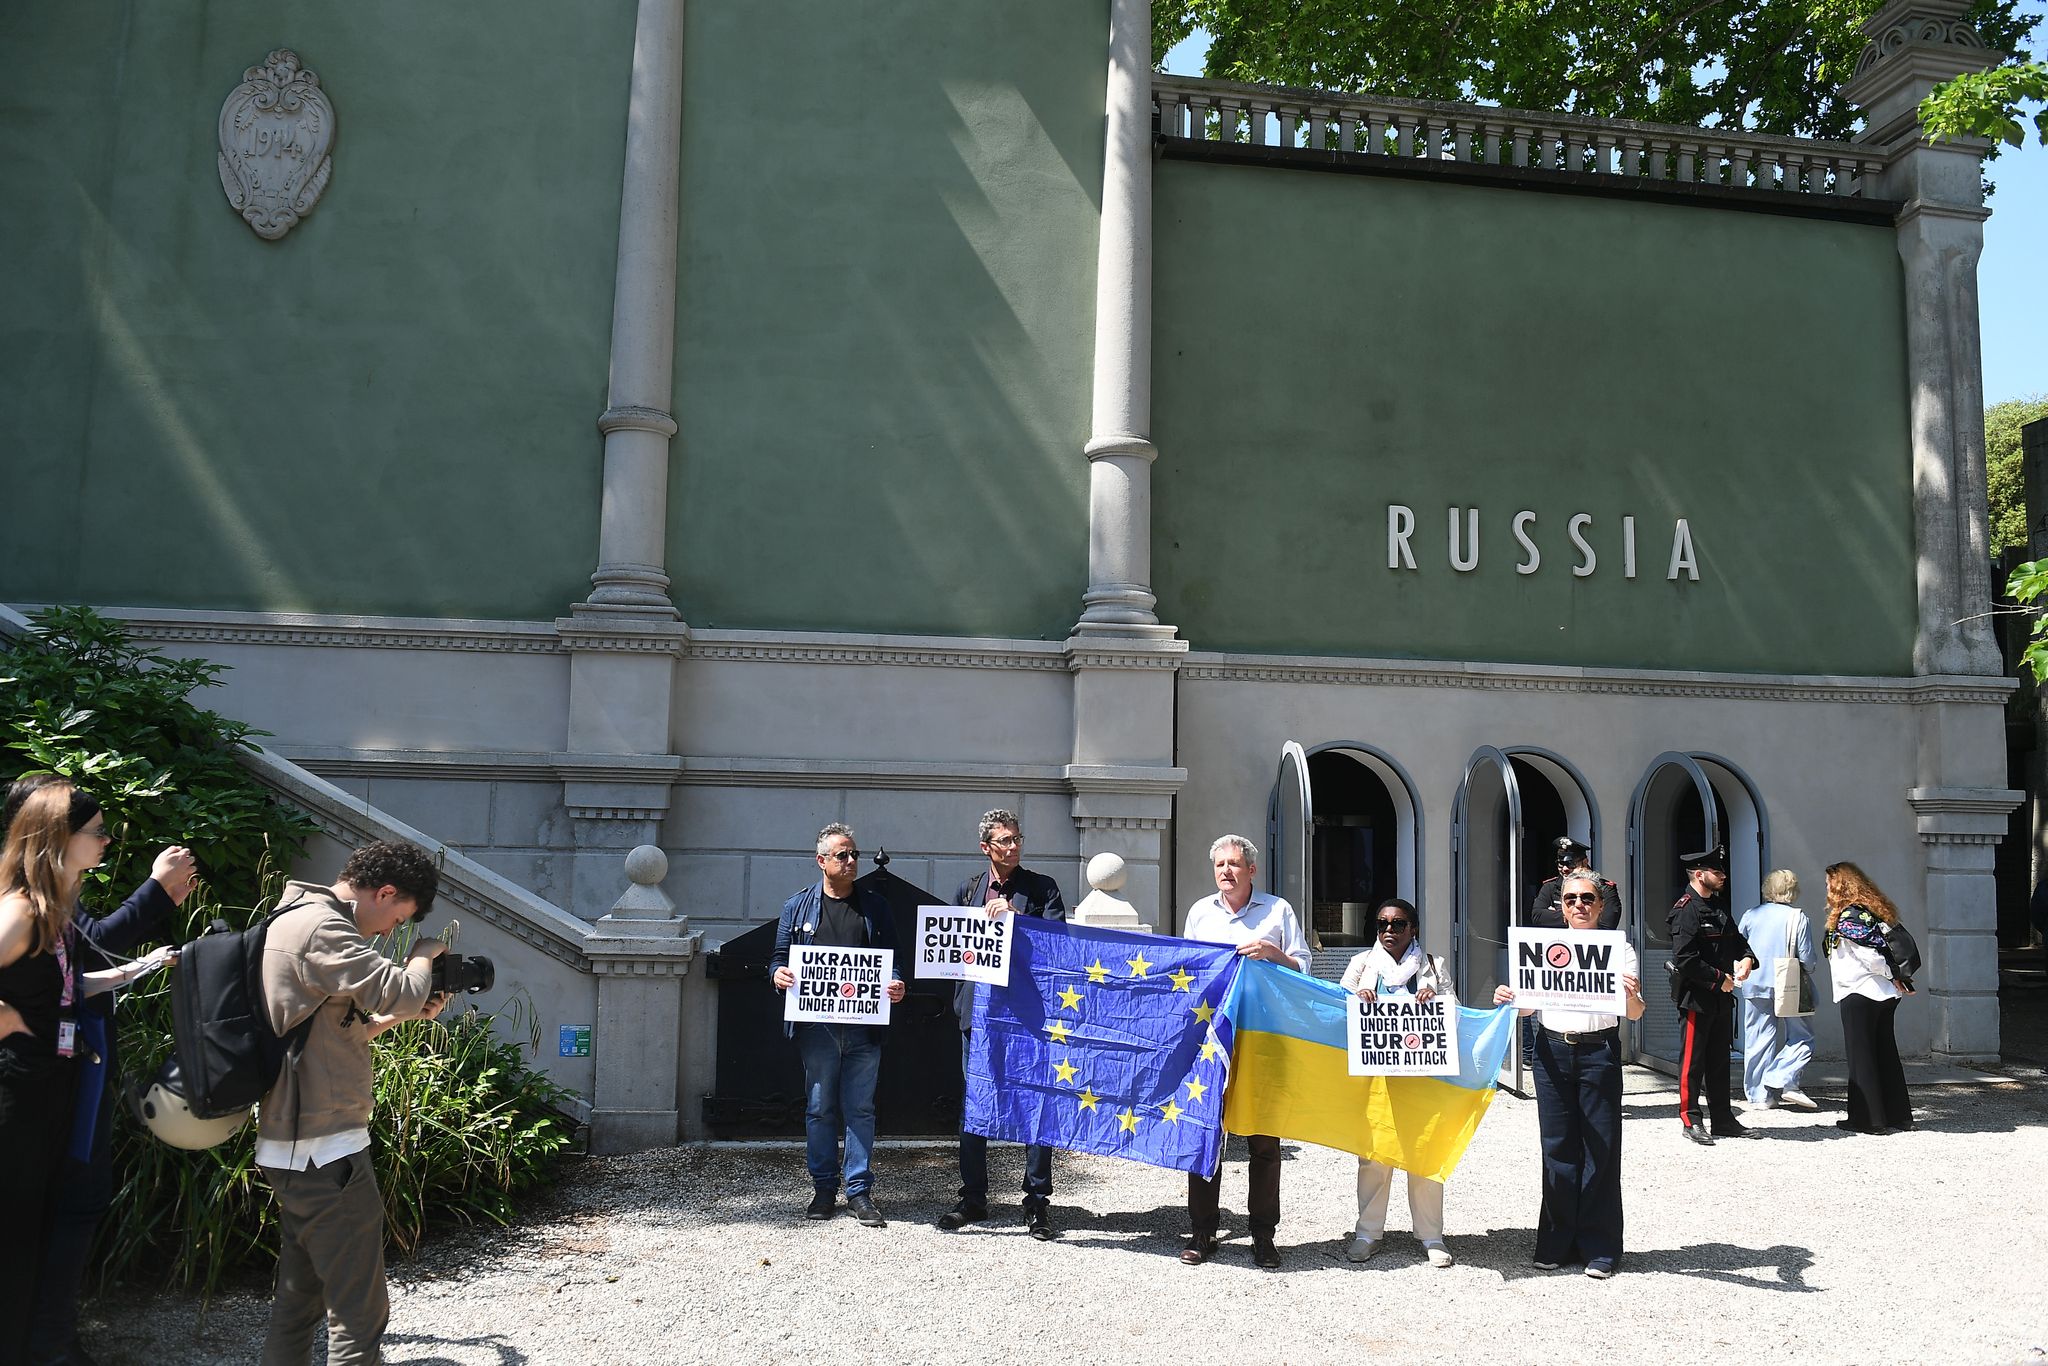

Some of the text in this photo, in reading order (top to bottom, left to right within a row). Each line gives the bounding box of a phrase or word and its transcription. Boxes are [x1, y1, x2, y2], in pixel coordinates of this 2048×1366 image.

[244, 127, 303, 158] 1914
[1387, 504, 1700, 581] RUSSIA
[925, 917, 1004, 937] PUTIN'S
[925, 934, 1003, 953] CULTURE
[802, 952, 882, 968] UKRAINE
[924, 949, 1001, 968] IS A BOMB
[1519, 941, 1612, 970] NOW
[801, 966, 881, 982] UNDER ATTACK
[1519, 969, 1616, 994] IN UKRAINE
[800, 981, 882, 999] EUROPE
[799, 997, 879, 1014] UNDER ATTACK
[1360, 1002, 1444, 1016] UKRAINE
[1360, 1017, 1445, 1032] UNDER ATTACK
[1361, 1033, 1447, 1049] EUROPE
[1361, 1051, 1447, 1065] UNDER ATTACK
